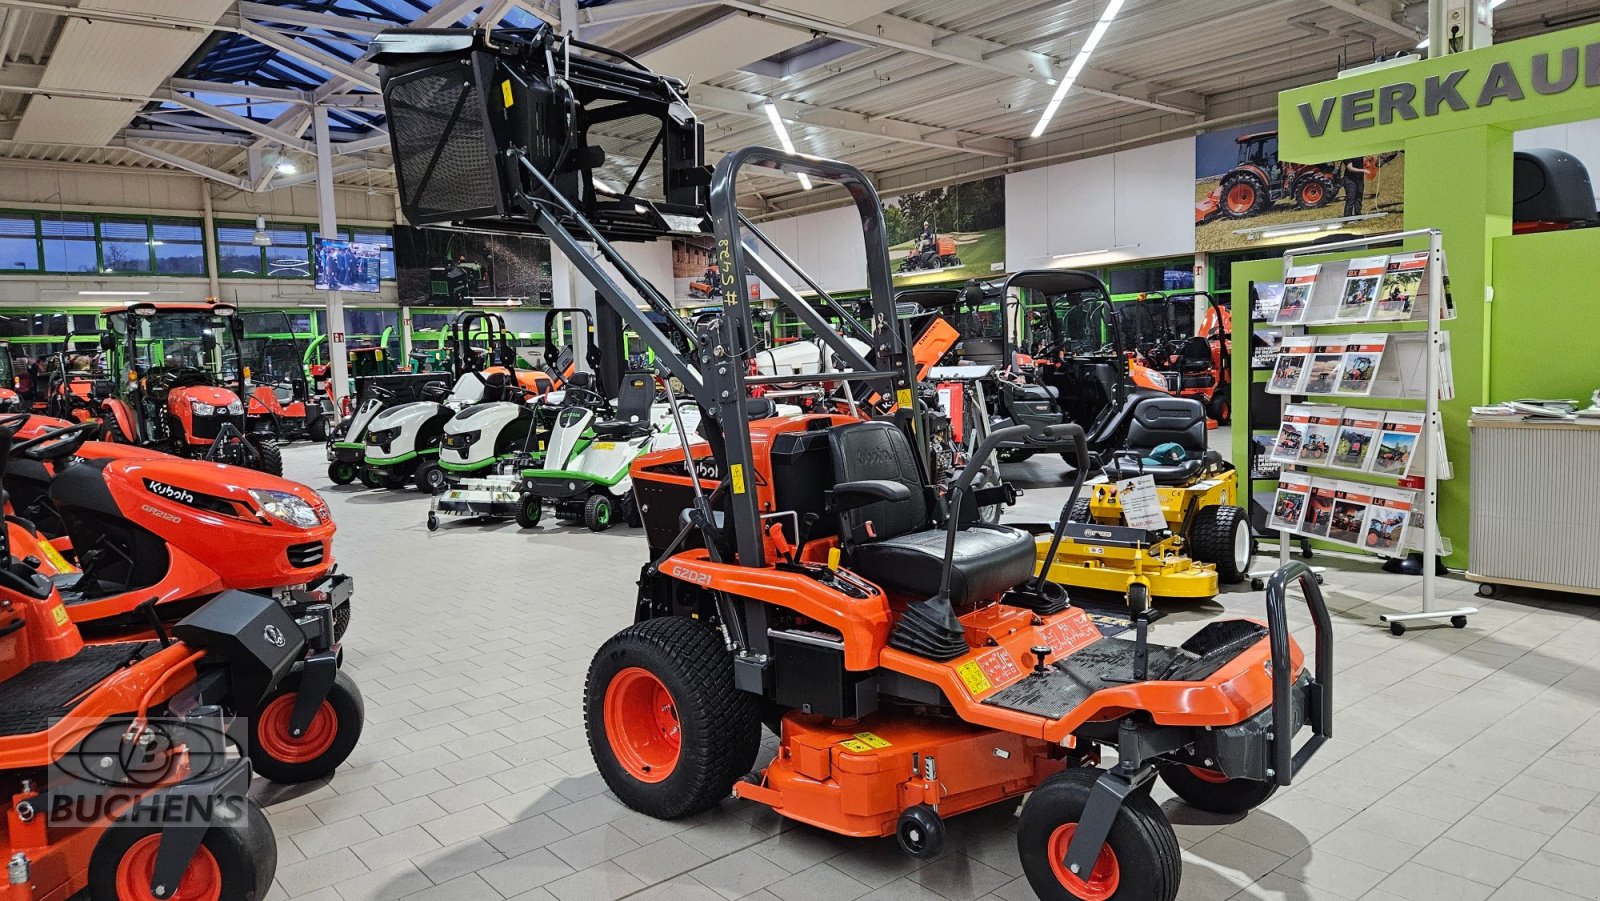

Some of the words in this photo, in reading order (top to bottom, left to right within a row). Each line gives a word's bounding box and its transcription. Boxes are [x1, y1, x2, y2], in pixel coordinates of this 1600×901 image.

[1344, 418, 1352, 426] M
[149, 480, 194, 503] Kubota
[141, 504, 182, 524] GR2120
[672, 565, 712, 585] GZD21
